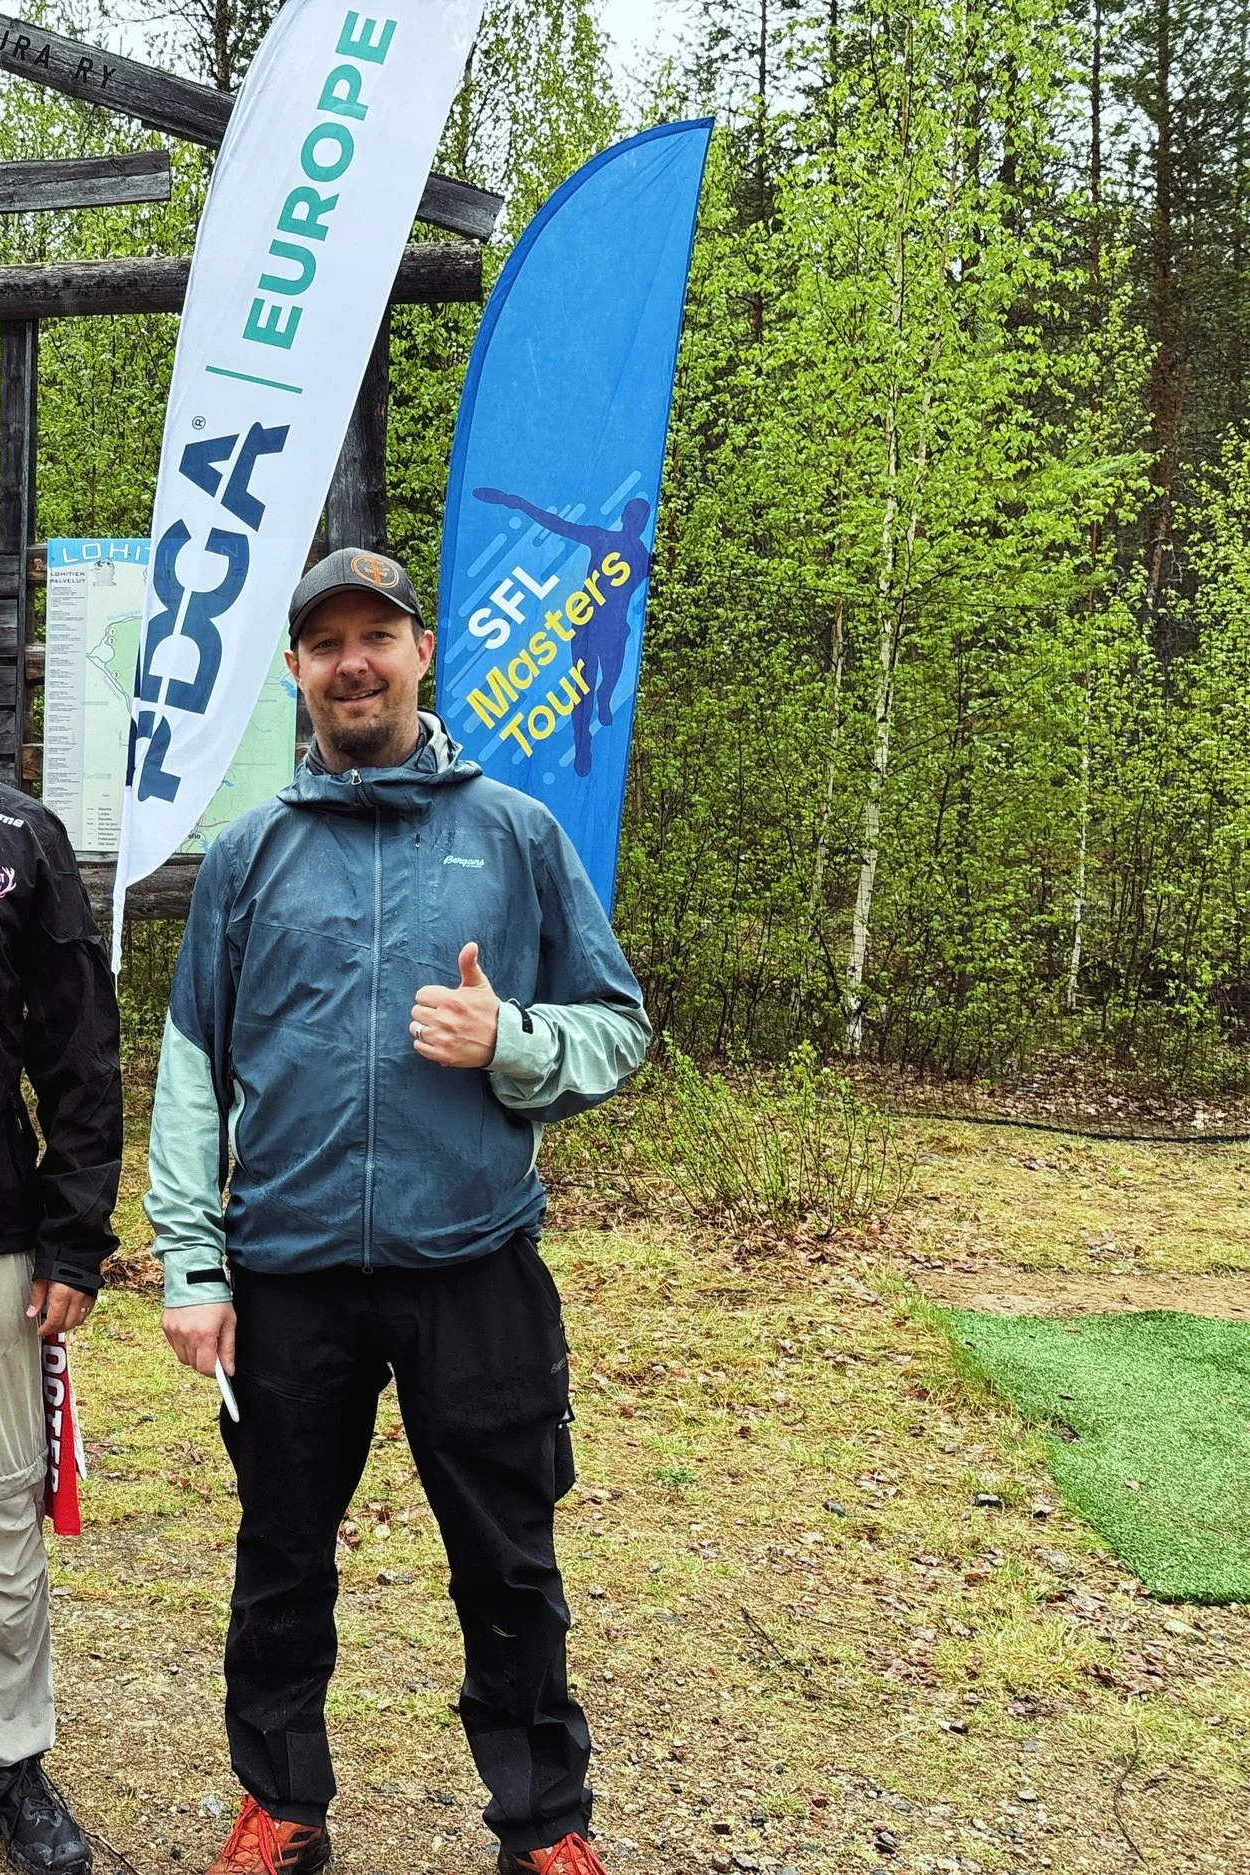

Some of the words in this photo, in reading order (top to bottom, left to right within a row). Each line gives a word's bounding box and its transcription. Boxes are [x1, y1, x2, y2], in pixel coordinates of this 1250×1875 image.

[71, 56, 117, 89] RY
[241, 9, 398, 351] EUROPE
[62, 542, 150, 563] LOHI
[137, 421, 291, 804] PDGA
[466, 551, 632, 730] Masters
[467, 565, 561, 650] SFL
[498, 657, 592, 758] Tour
[443, 855, 485, 868] Bergans
